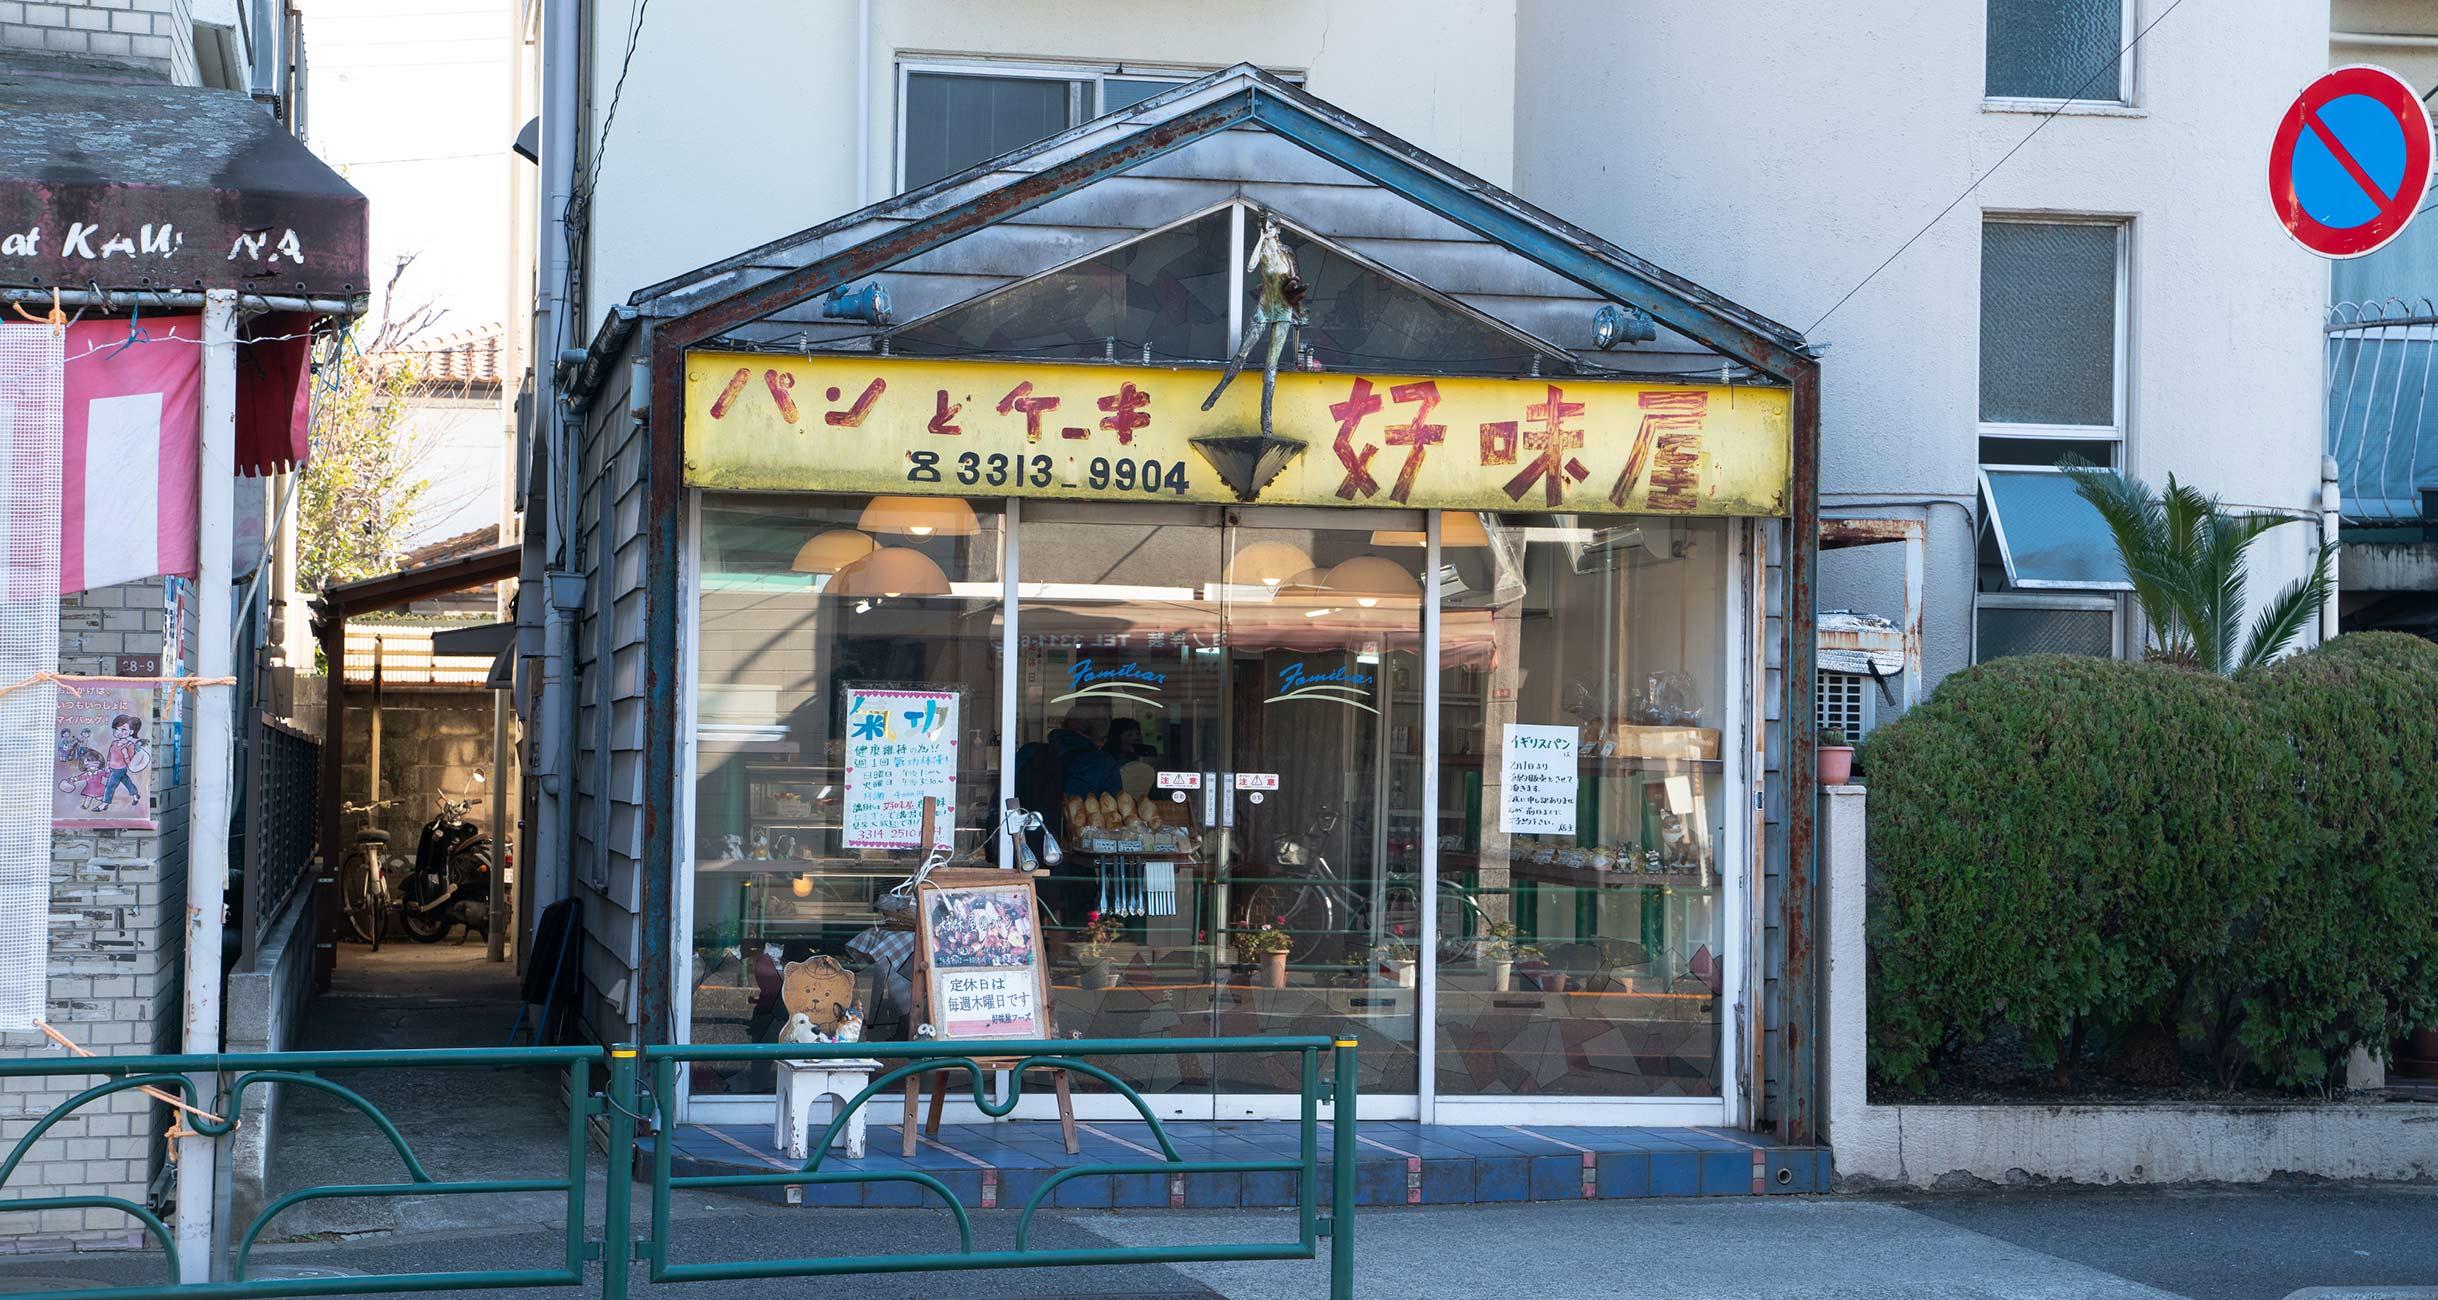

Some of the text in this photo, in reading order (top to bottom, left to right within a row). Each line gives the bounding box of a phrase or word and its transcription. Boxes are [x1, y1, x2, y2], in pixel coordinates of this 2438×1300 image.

[1, 226, 40, 256] at
[709, 367, 1151, 446] パンとケーキ
[1328, 376, 1709, 509] 好味屋
[1067, 658, 1167, 688] Familiar
[56, 701, 129, 710] いつもいっしょに
[1511, 735, 1571, 750] イギリスパン
[950, 977, 1005, 992] 定休日は
[947, 991, 1030, 1012] 毎週木曜日です
